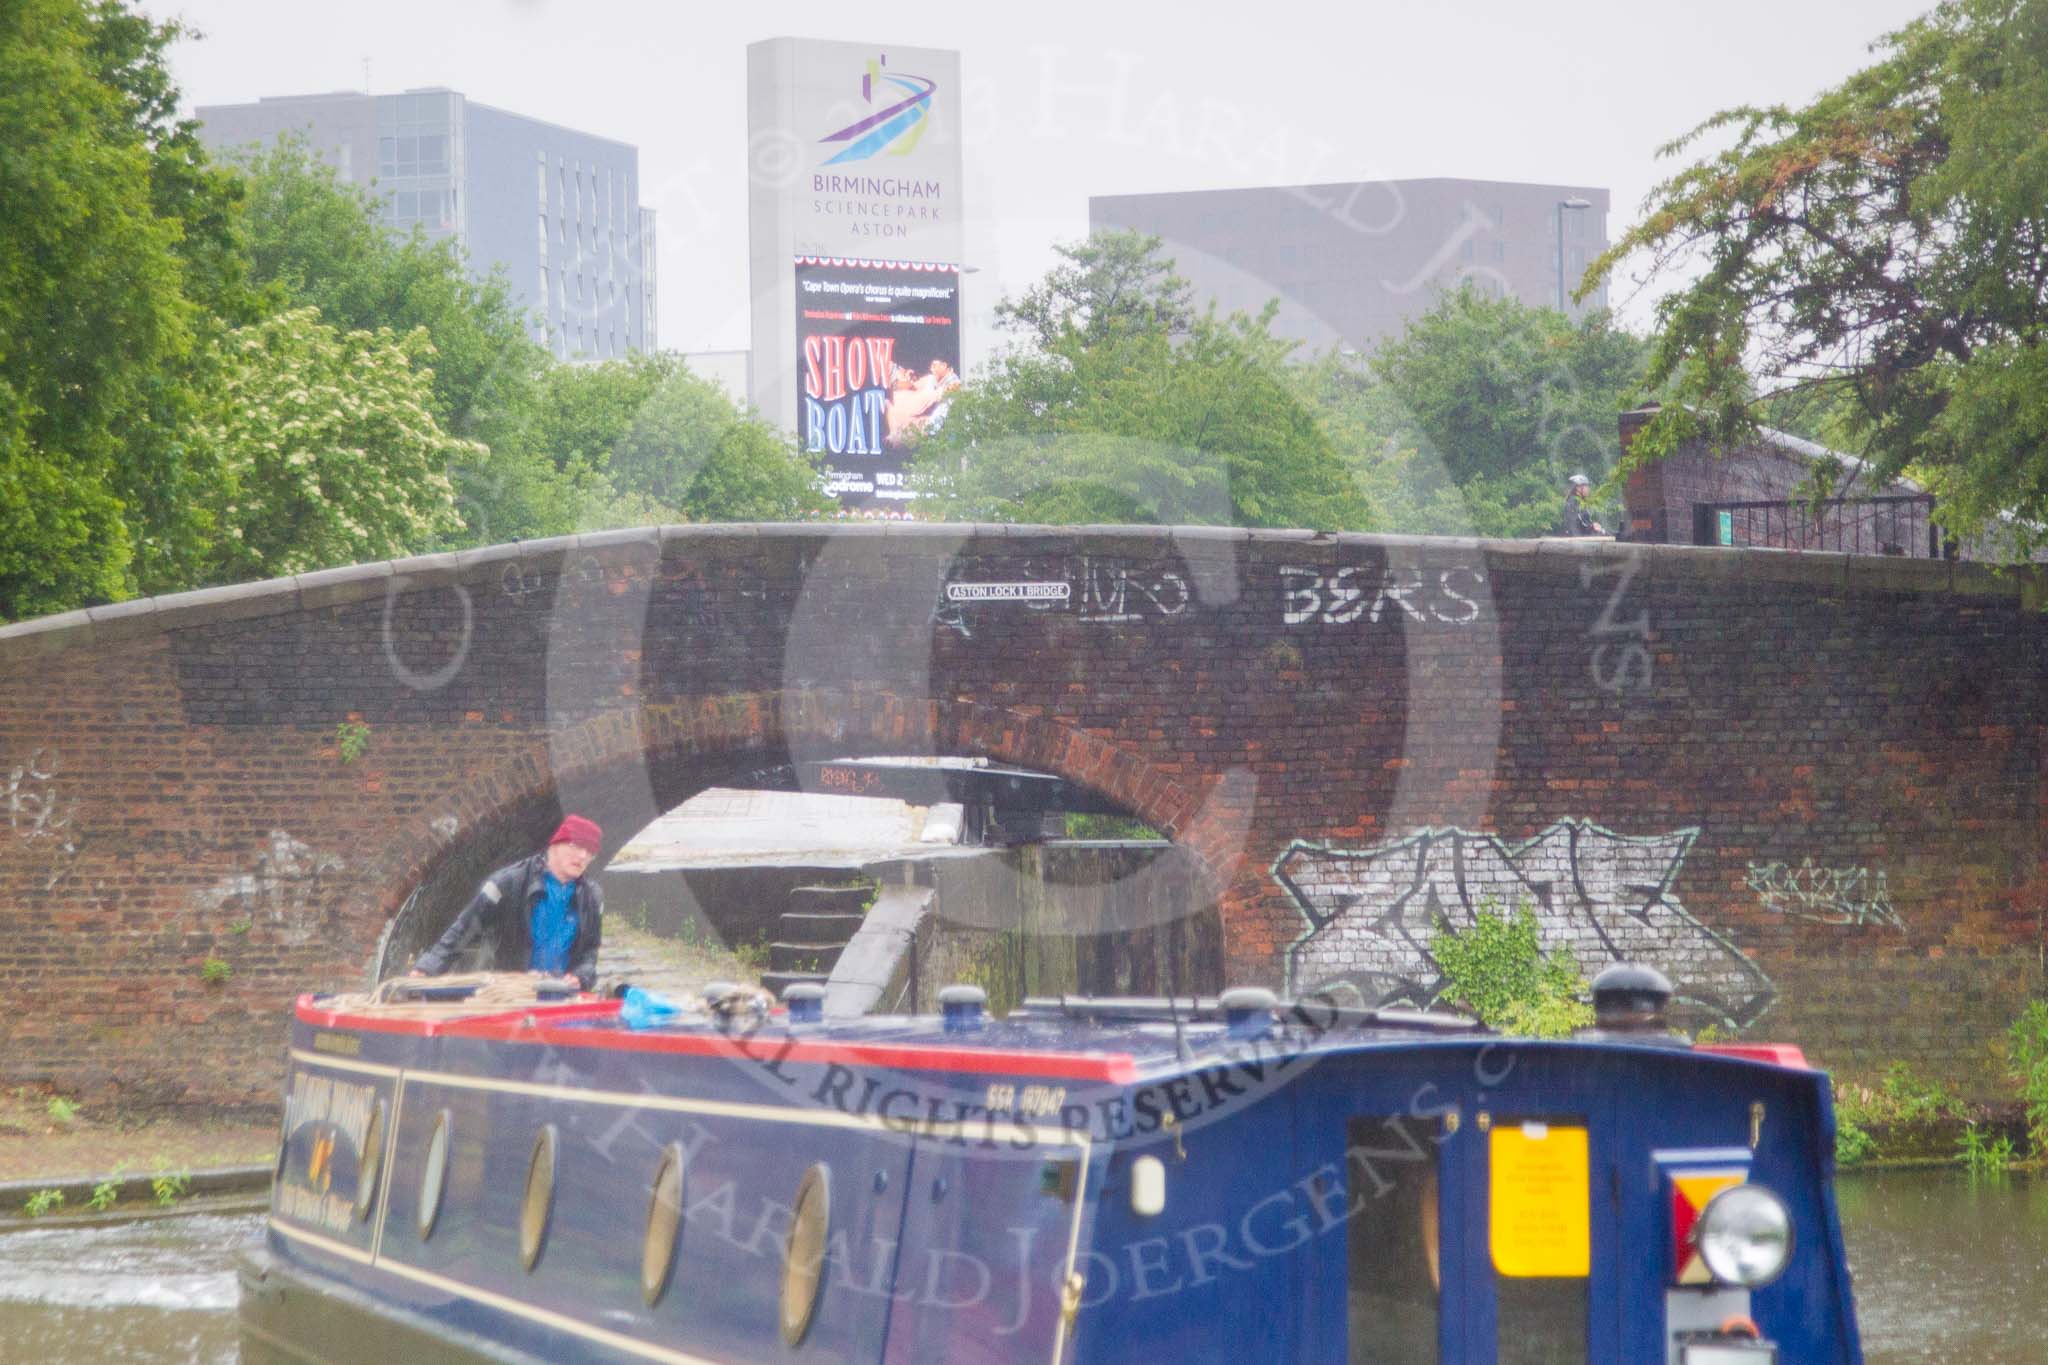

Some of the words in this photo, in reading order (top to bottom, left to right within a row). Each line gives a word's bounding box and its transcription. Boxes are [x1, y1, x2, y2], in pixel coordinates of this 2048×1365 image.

[813, 174, 941, 198] BIRMINGHAM
[814, 200, 890, 217] SCIENCE
[897, 206, 940, 220] PARK
[851, 223, 907, 237] ASTON
[823, 281, 839, 293] Town
[865, 283, 887, 296] chorus
[888, 286, 893, 296] is
[894, 286, 911, 298] quite
[805, 336, 895, 399] SHOW
[805, 389, 887, 455] BOAT
[876, 473, 896, 486] WED
[953, 585, 987, 598] ASTON
[989, 585, 1017, 597] LOCK
[1026, 585, 1065, 597] BRIDGE
